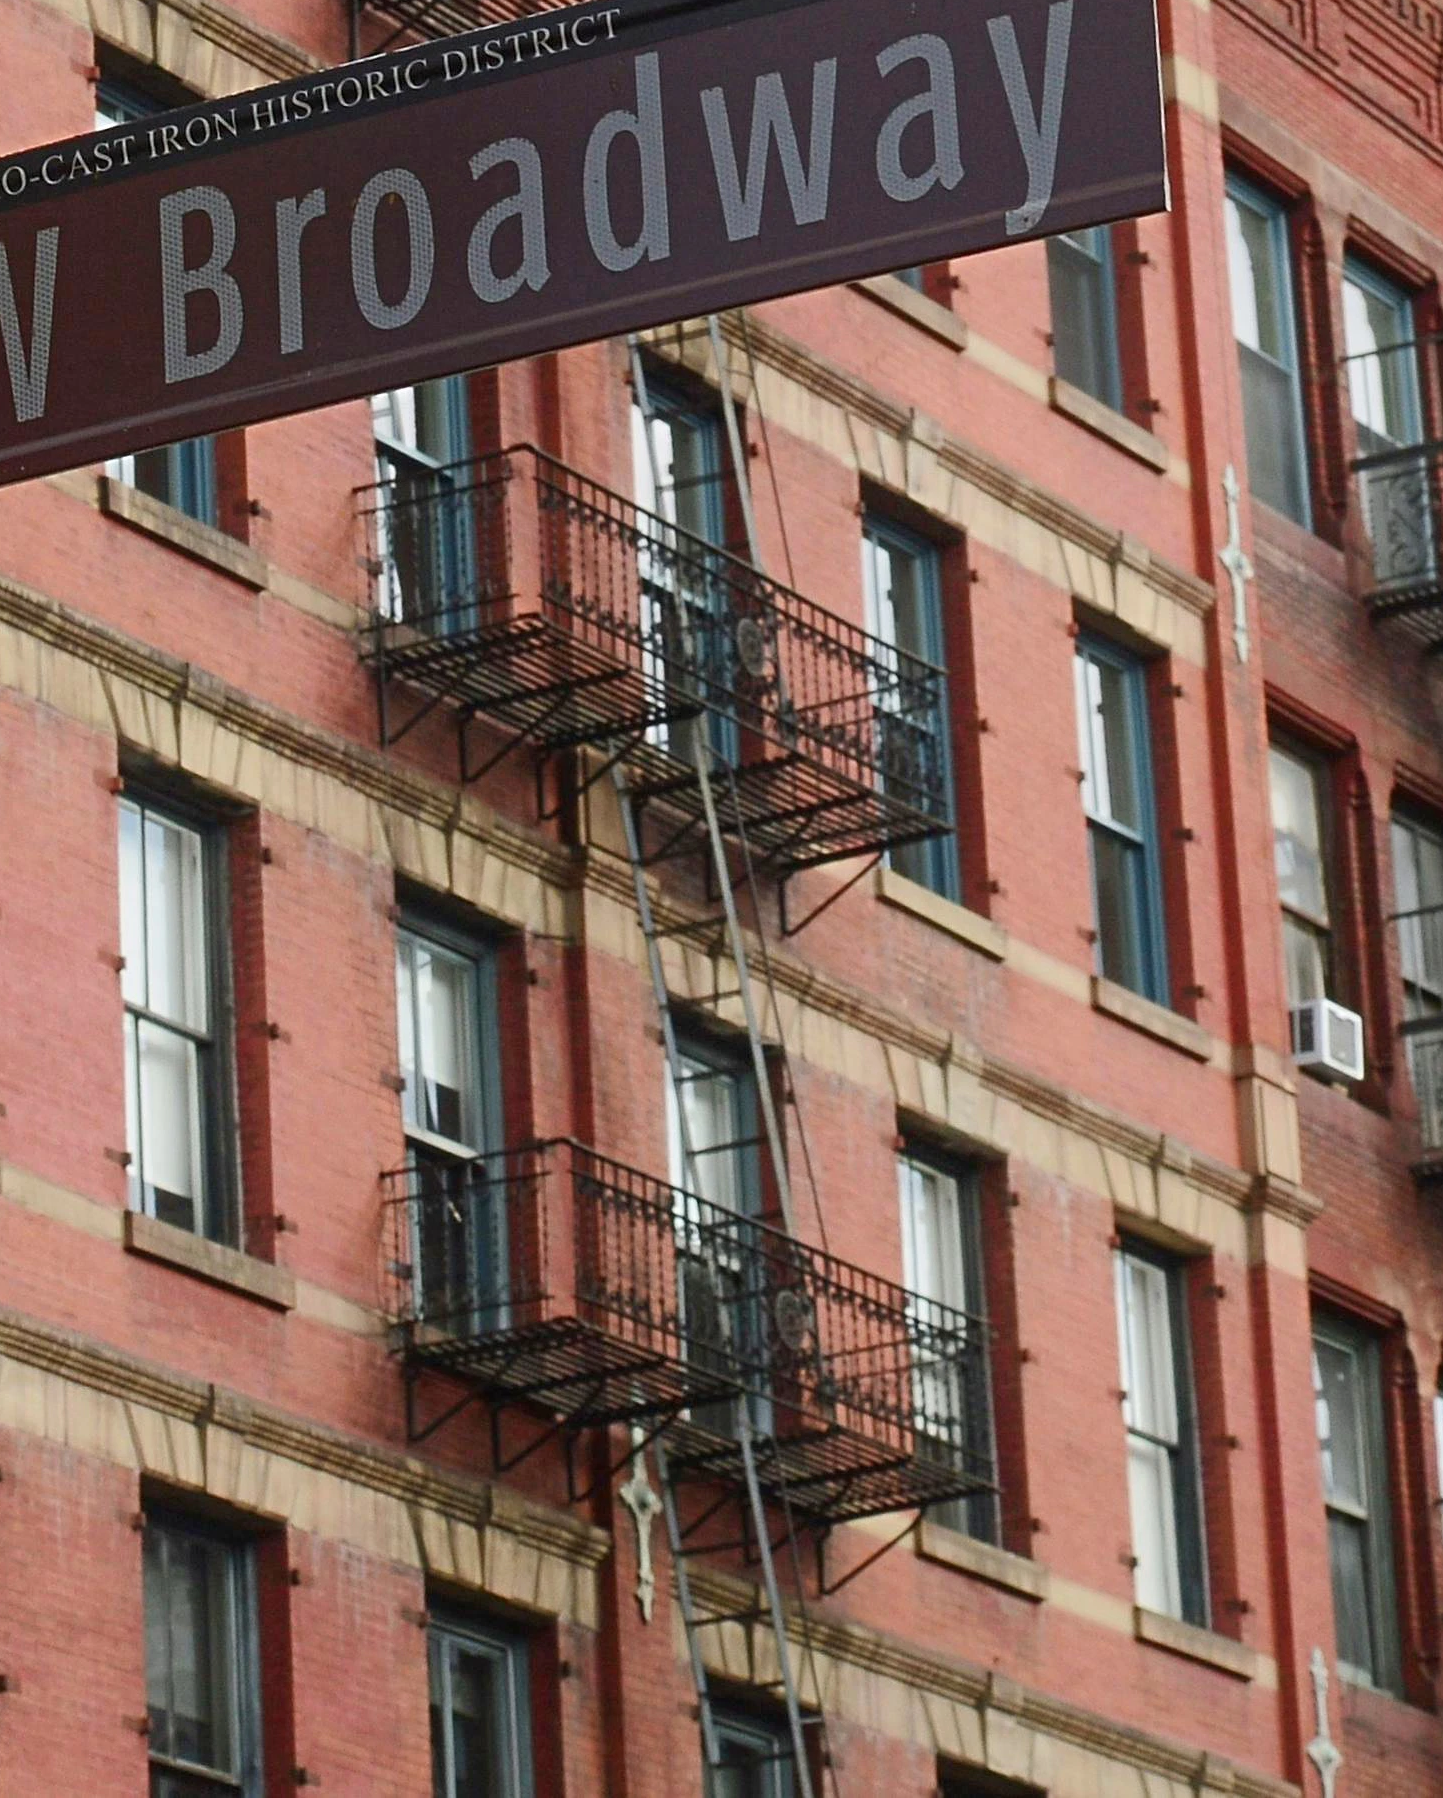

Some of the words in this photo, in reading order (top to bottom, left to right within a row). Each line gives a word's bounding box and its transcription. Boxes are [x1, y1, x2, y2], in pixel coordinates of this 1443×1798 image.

[144, 108, 239, 156] IRON
[251, 59, 430, 131] HISTORIC
[441, 8, 622, 82] DISTRICT
[158, 0, 1076, 385] Broadway
